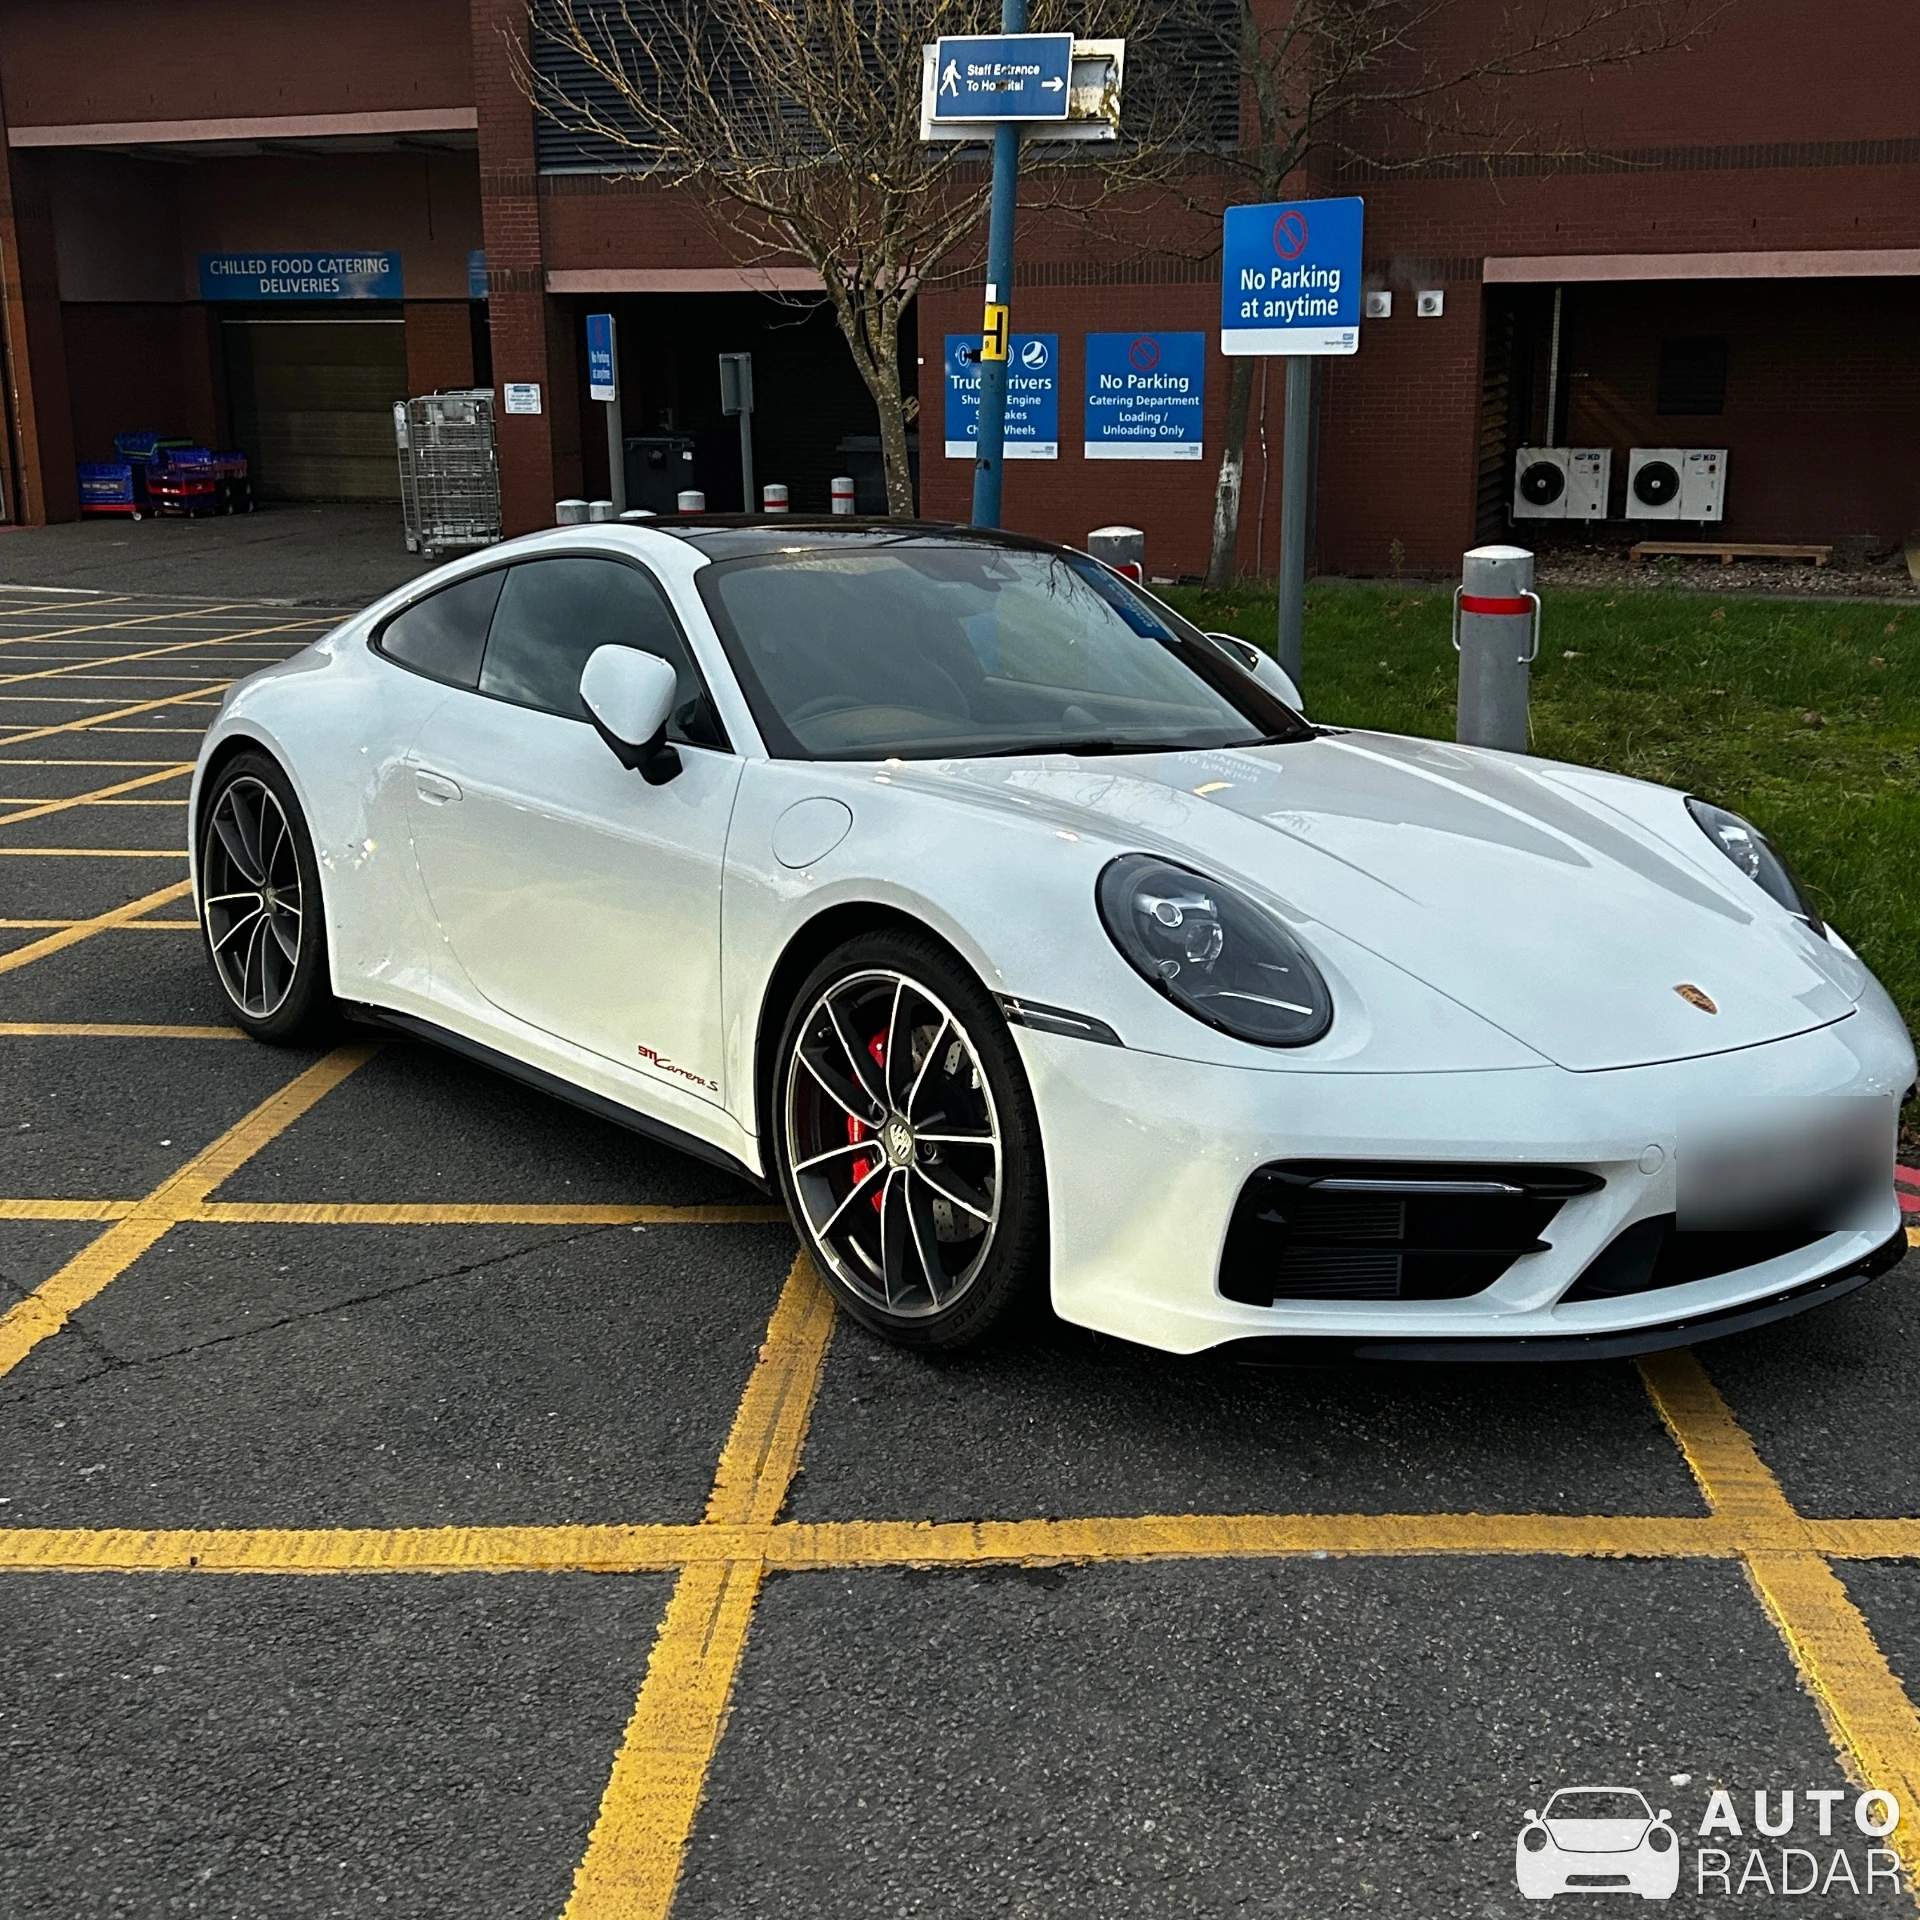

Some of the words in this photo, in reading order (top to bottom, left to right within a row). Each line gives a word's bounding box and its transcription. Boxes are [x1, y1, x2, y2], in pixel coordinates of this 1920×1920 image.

[967, 63, 992, 76] Staff
[967, 80, 979, 92] To
[981, 79, 1024, 93] Hoital
[209, 260, 267, 275] CHILLED
[271, 259, 313, 274] FOOD
[317, 258, 390, 274] CATERING
[259, 278, 340, 293] DELIVERIES
[1240, 268, 1266, 291] No
[1270, 264, 1341, 293] Parking
[1240, 297, 1259, 319] at
[1263, 293, 1339, 323] anytime
[950, 375, 982, 390] Truc
[1008, 375, 1052, 390] rivers
[1100, 374, 1123, 389] No
[1127, 372, 1189, 393] Parking
[961, 394, 980, 405] Shu
[1006, 394, 1041, 407] Engine
[1089, 395, 1134, 408] Catering
[1136, 395, 1200, 408] Department
[1004, 409, 1027, 420] akes
[1119, 411, 1161, 424] Loading
[1163, 412, 1169, 422] /
[1103, 425, 1157, 438] Unloading
[1159, 425, 1185, 438] Only
[654, 1058, 706, 1086] Carrera
[706, 1080, 719, 1092] S
